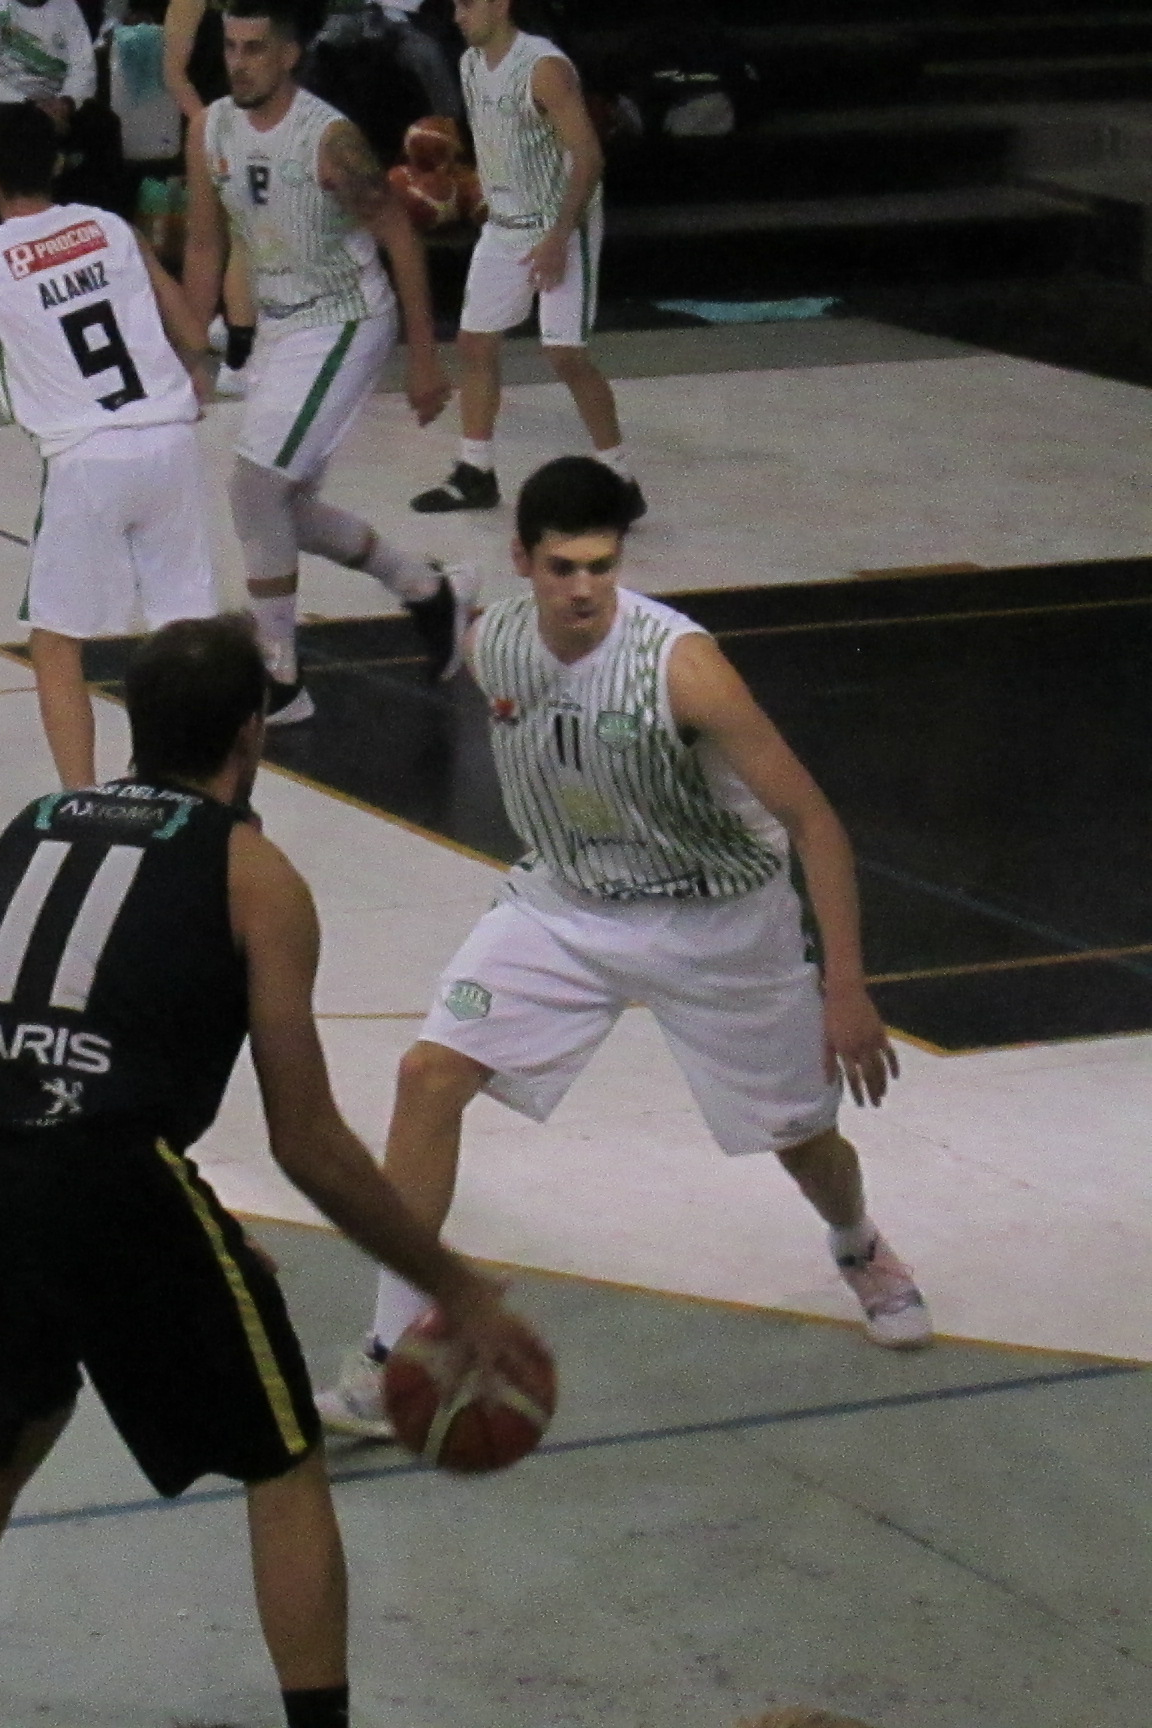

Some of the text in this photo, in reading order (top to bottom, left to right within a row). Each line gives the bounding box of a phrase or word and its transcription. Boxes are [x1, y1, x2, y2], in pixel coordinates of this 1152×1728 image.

[38, 261, 110, 310] ALANIZ
[59, 299, 148, 411] 9
[554, 714, 582, 771] 11
